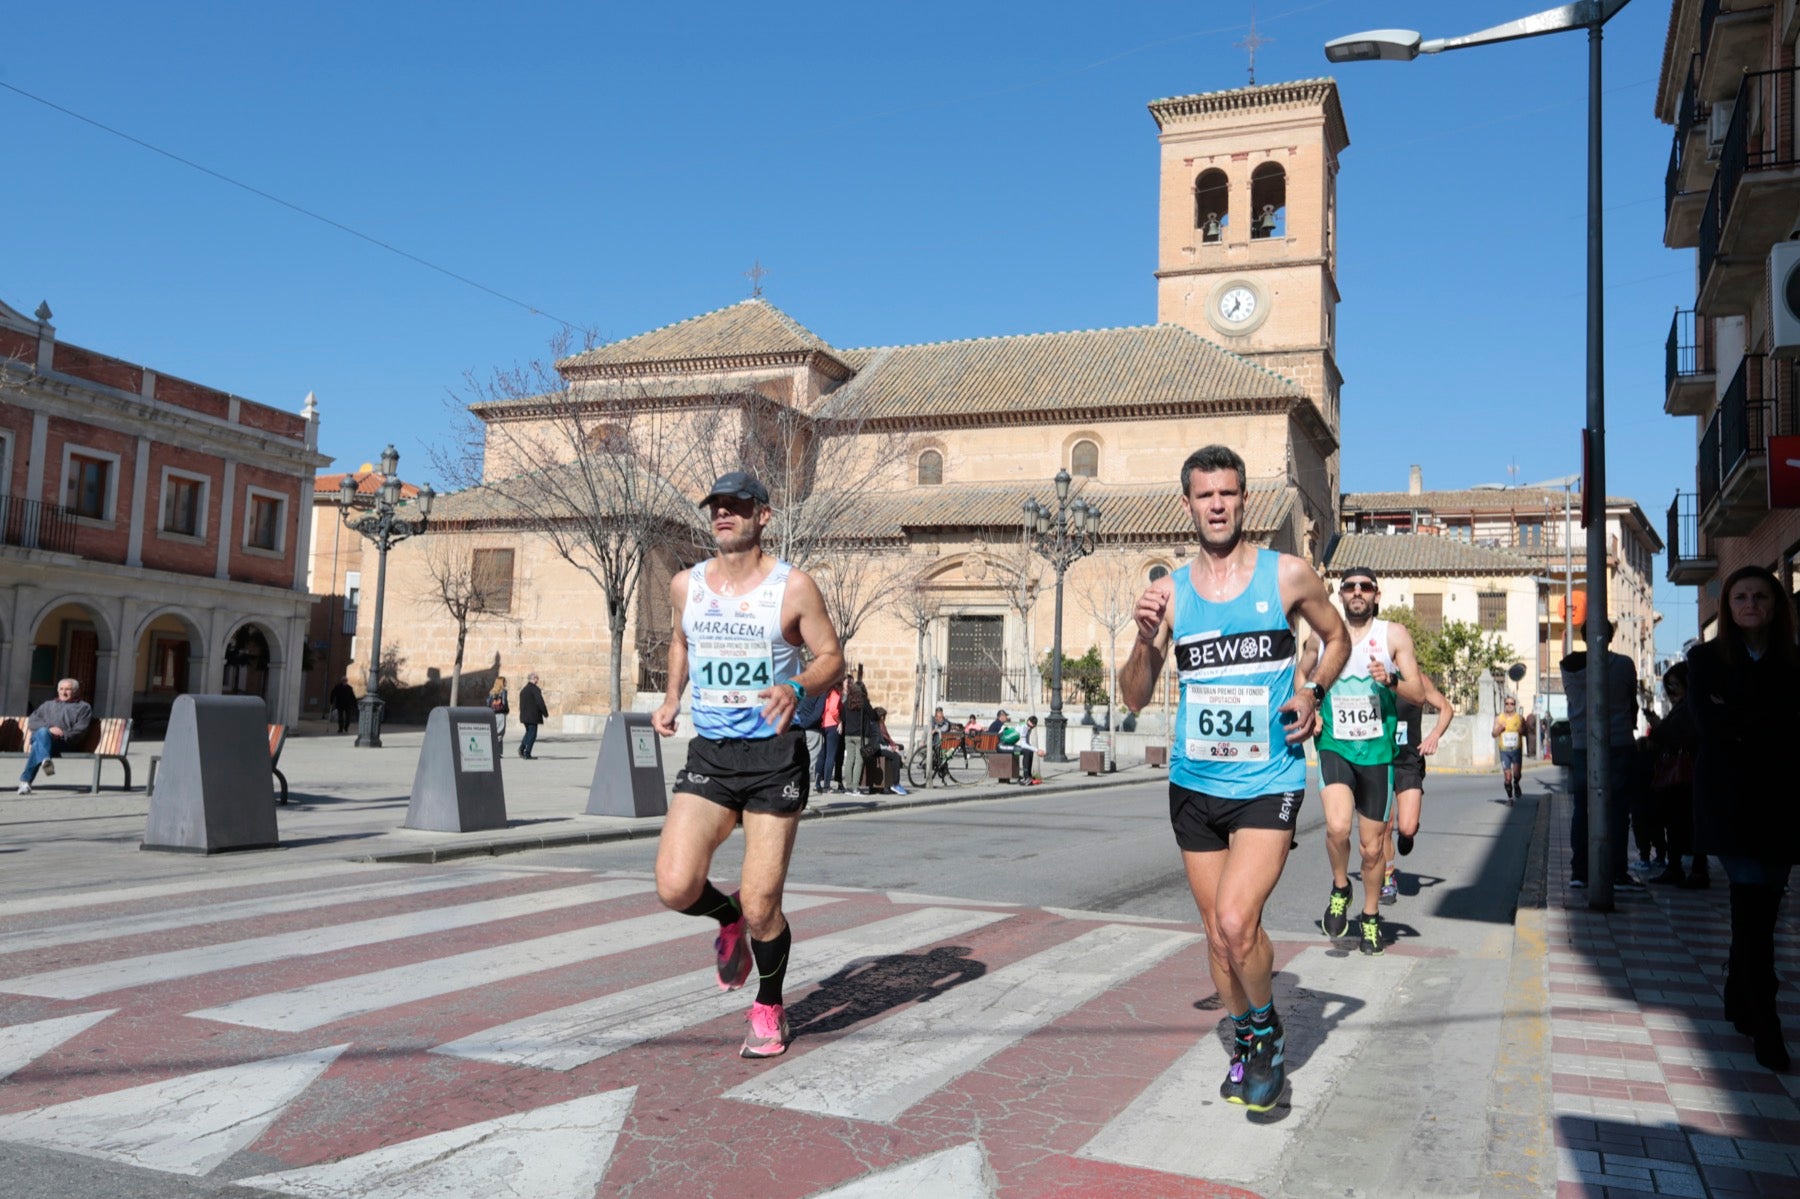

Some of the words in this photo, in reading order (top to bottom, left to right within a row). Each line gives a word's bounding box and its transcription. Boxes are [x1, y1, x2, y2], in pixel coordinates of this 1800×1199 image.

[692, 621, 765, 638] MARACENA
[1189, 635, 1272, 666] BEWOR
[702, 661, 769, 686] 1024
[1217, 687, 1236, 696] PREMIO
[1238, 688, 1243, 696] DE
[1199, 709, 1254, 737] 634
[1338, 708, 1378, 724] 3164
